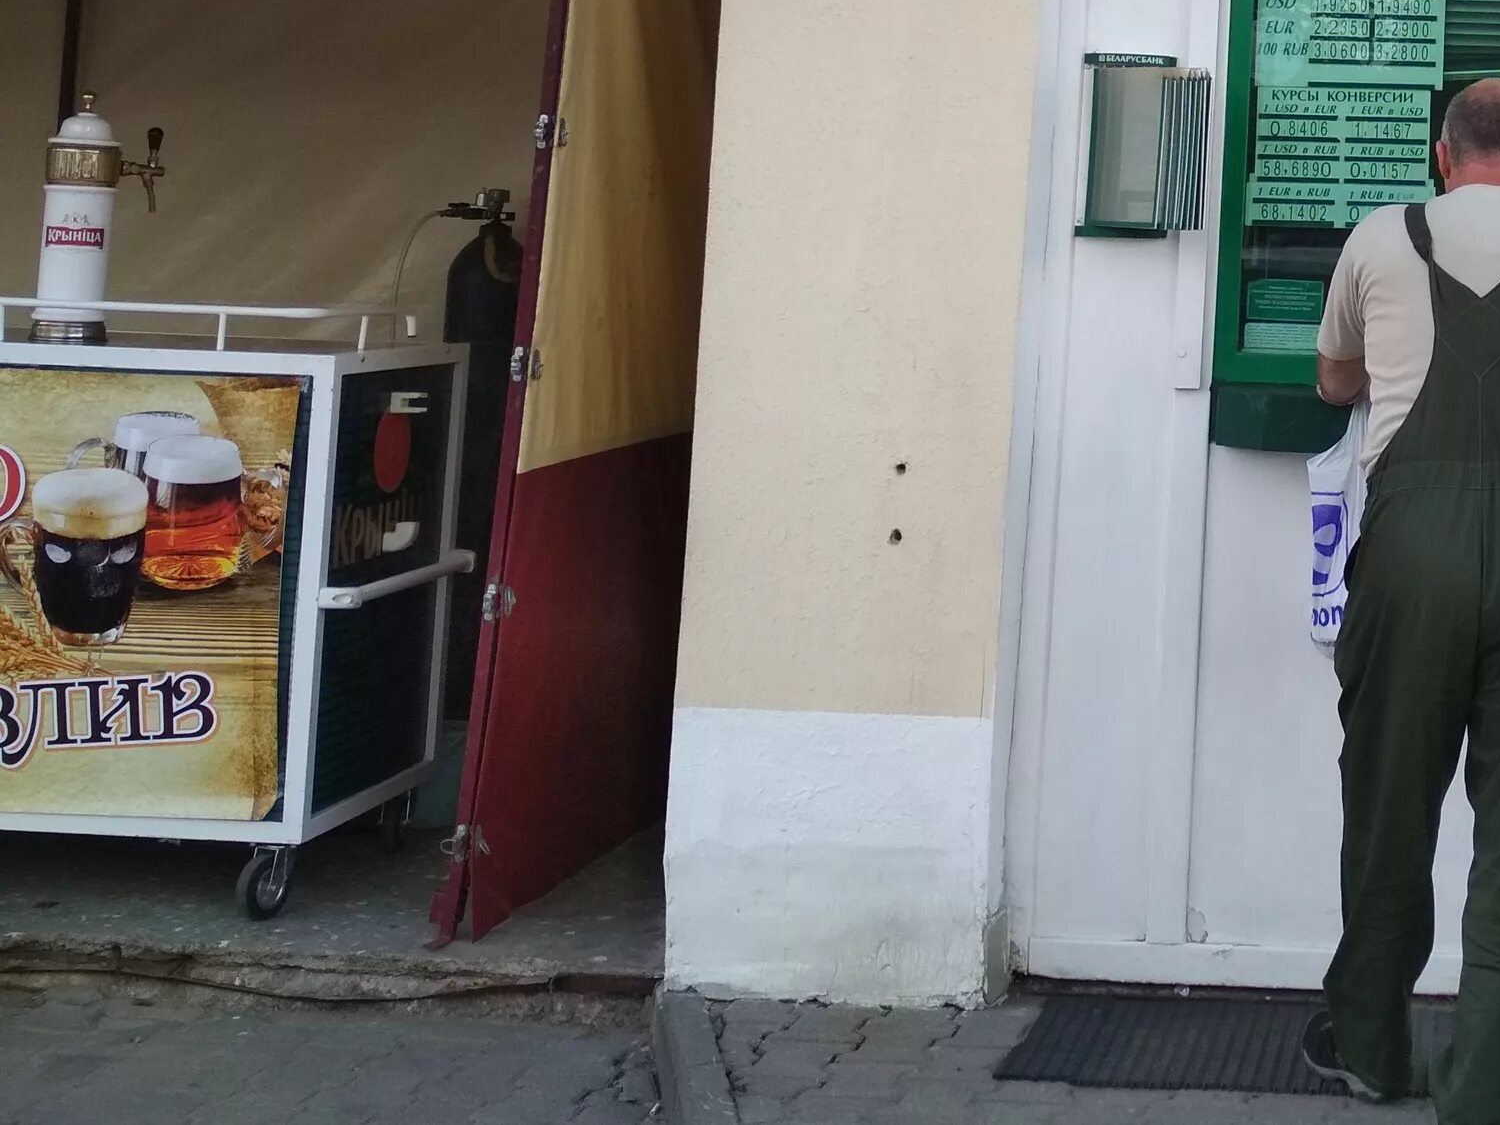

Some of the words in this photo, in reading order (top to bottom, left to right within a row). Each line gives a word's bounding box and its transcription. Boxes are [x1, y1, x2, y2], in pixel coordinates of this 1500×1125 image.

[1377, 0, 1432, 15] 1,9490
[1265, 20, 1295, 34] EUR
[1283, 42, 1309, 56] RUB
[1106, 54, 1165, 65] БЕЛАРУСБАНК
[1271, 90, 1319, 101] КУРСЫ
[1327, 91, 1414, 103] КОНВЕРСИИ
[1275, 104, 1299, 113] USD
[1315, 105, 1337, 114] EUR
[1361, 106, 1383, 115] EUR
[1400, 107, 1424, 116] USD
[1274, 144, 1298, 153] USD
[1314, 145, 1337, 154] RUB
[1360, 147, 1384, 156] RUB
[1400, 147, 1424, 157] USD
[1263, 161, 1331, 177] 58,6890
[1350, 163, 1410, 179] 0,0157
[1269, 187, 1291, 196] EUR
[1307, 188, 1331, 197] RUB
[1360, 190, 1384, 199] RUB
[1261, 205, 1328, 221] 68,1402
